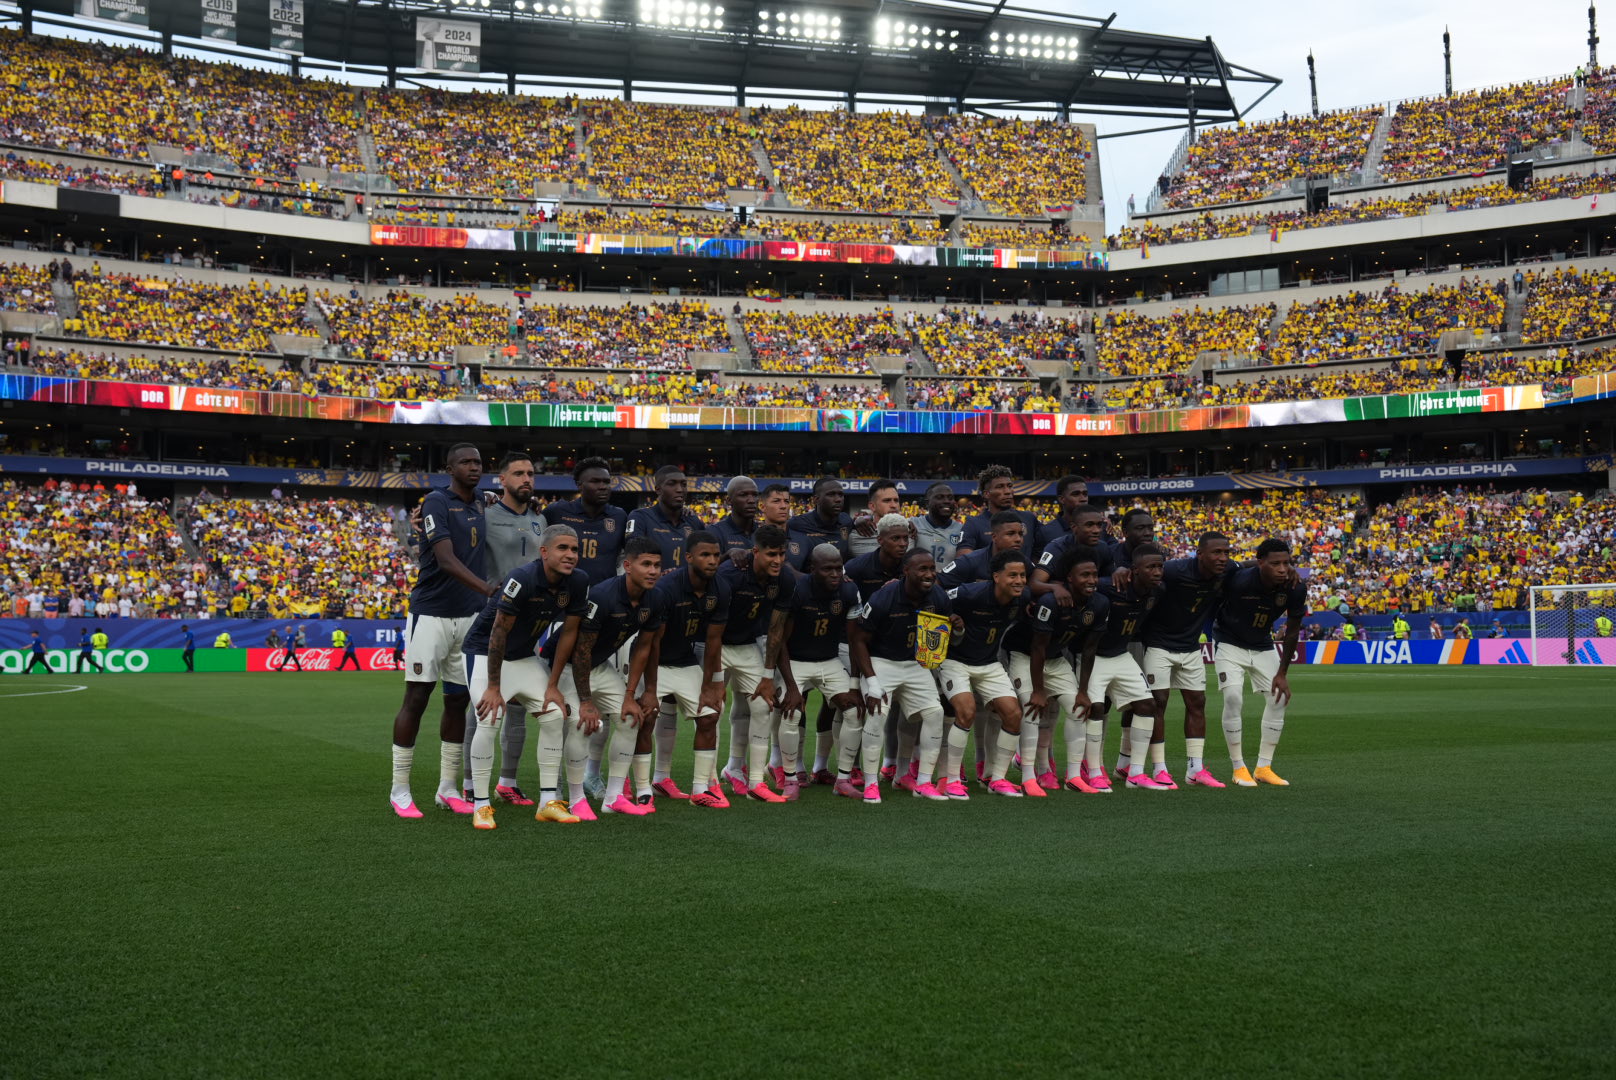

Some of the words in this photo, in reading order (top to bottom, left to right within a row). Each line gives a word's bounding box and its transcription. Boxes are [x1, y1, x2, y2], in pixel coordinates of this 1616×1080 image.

[99, 0, 146, 15] CHAMPIONS
[273, 8, 301, 22] 2022
[445, 29, 472, 41] 2024
[437, 52, 478, 63] CHAMPIONS
[445, 45, 470, 55] WORLD
[141, 390, 164, 403] DOR
[195, 392, 222, 407] CÔTE
[1420, 396, 1444, 410] CÔTE
[1446, 395, 1490, 408] D'IVOIRE
[560, 409, 582, 422] CÔTE
[583, 411, 622, 423] D'IVOIRE
[1033, 418, 1051, 430] DOR
[1075, 418, 1098, 431] CÔTE
[86, 461, 229, 477] PHILADELPHIA
[1380, 463, 1517, 478] PHILADELPHIA
[1103, 483, 1140, 492] WORLD
[1140, 482, 1158, 490] CUP
[1160, 480, 1194, 489] 2026
[470, 527, 478, 548] 6
[521, 536, 526, 557] 1
[581, 538, 599, 559] 16
[930, 545, 945, 563] 12
[673, 546, 681, 566] 4
[748, 602, 760, 619] 3
[685, 619, 700, 637] 15
[814, 618, 830, 637] 13
[1120, 619, 1137, 636] 14
[1252, 612, 1269, 629] 19
[906, 631, 916, 648] 9
[986, 627, 997, 645] 8
[1357, 640, 1413, 664] VISA
